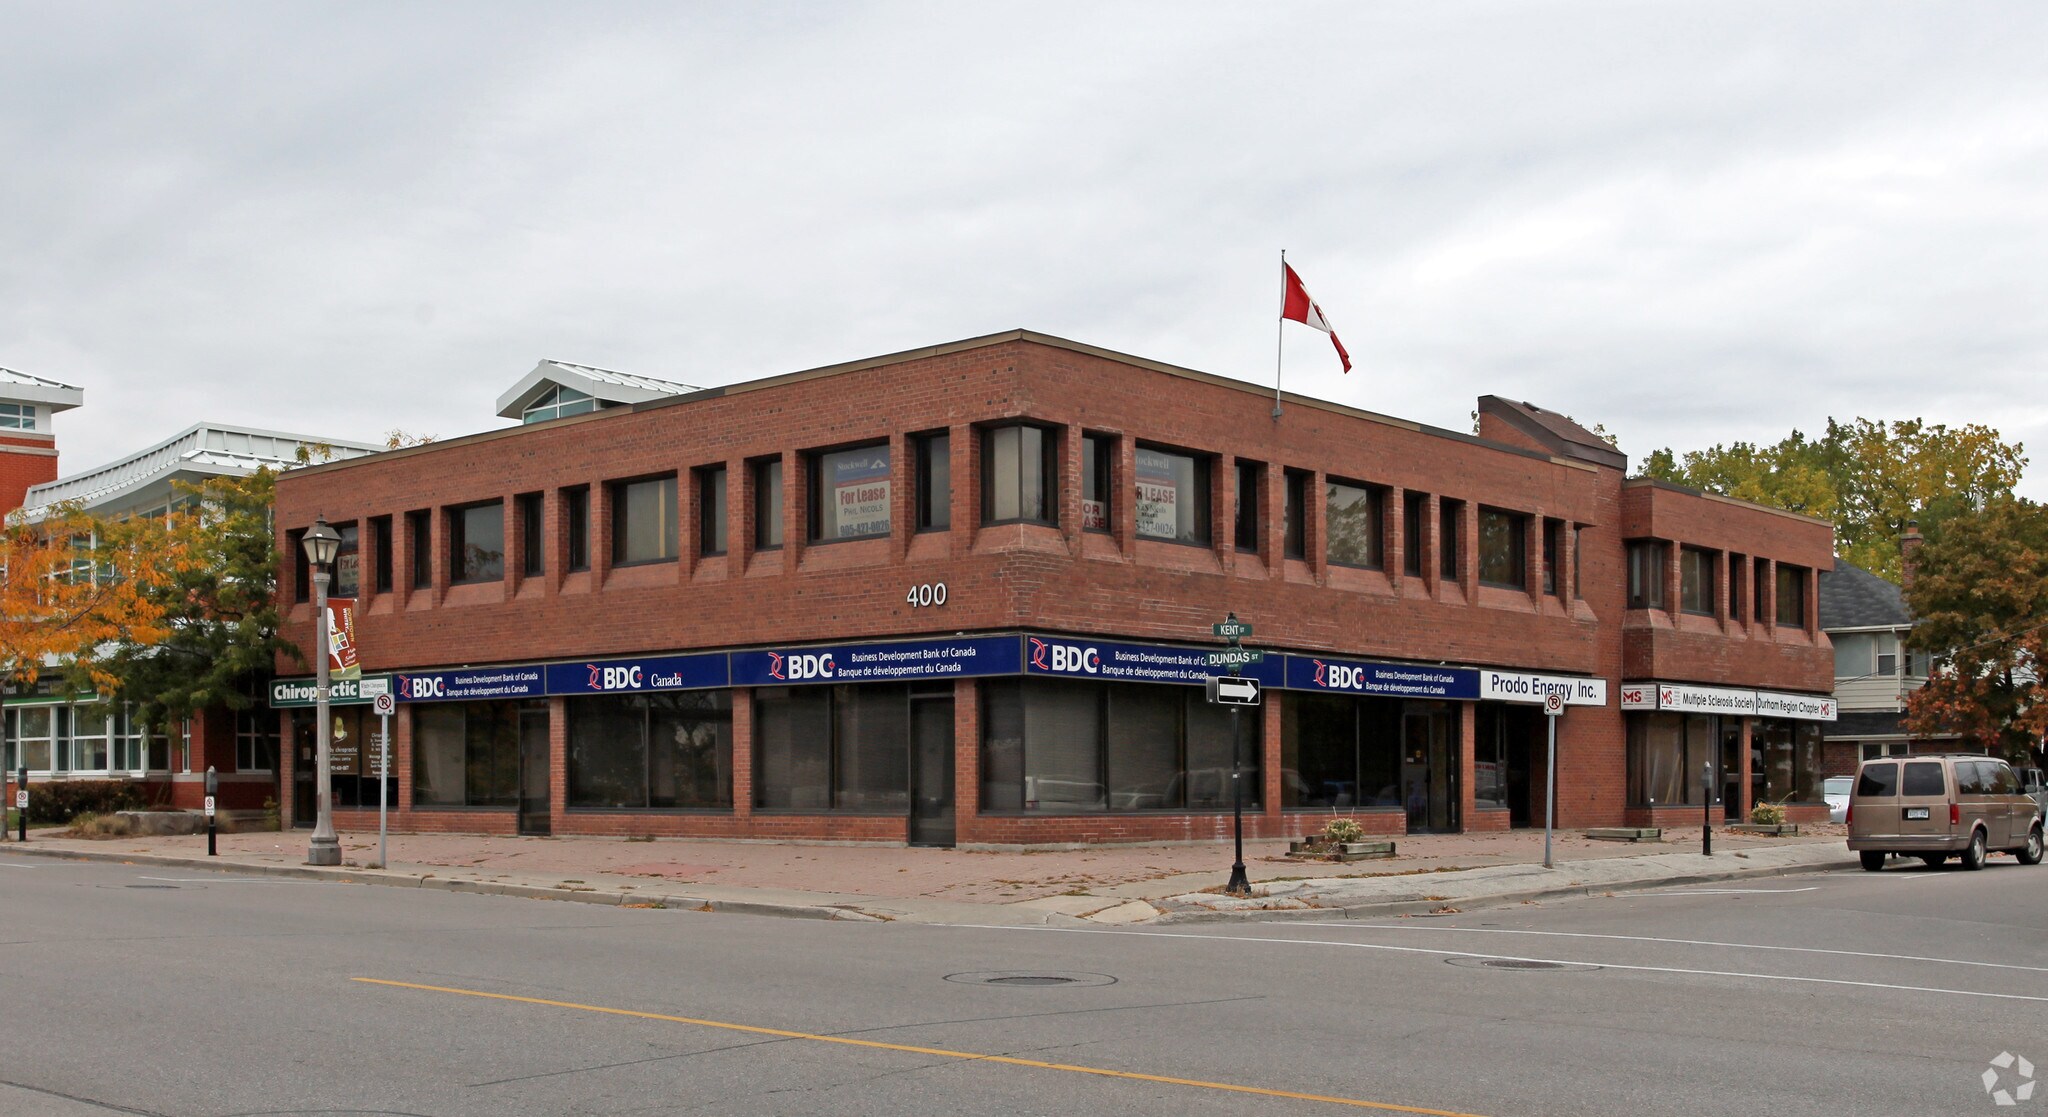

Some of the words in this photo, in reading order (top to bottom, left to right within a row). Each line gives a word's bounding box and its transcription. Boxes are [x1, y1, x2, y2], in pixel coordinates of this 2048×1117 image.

[841, 491, 855, 505] For
[857, 487, 886, 503] Lease
[1145, 487, 1175, 504] LEASE
[1083, 504, 1100, 515] OR
[1083, 517, 1104, 528] ASE
[907, 583, 947, 608] 400
[1221, 625, 1239, 635] KENT
[852, 654, 878, 663] Business
[879, 652, 922, 661] Development
[924, 650, 940, 658] Bank
[942, 648, 949, 657] of
[950, 647, 976, 657] Canada
[1052, 645, 1097, 673] BDC
[1116, 652, 1139, 662] Business
[1140, 653, 1177, 665] Development
[1178, 656, 1194, 666] Bank
[1195, 656, 1200, 666] of
[1210, 653, 1250, 664] DUNDAS
[789, 654, 833, 679] BDC
[839, 668, 862, 678] Banque
[864, 667, 871, 675] de
[873, 665, 923, 677] développement
[925, 664, 934, 673] du
[936, 663, 961, 672] Canada
[1103, 665, 1125, 675] Banque
[1126, 667, 1134, 675] de
[1135, 667, 1179, 679] développement
[1180, 670, 1187, 679] du
[1189, 670, 1209, 680] Canada
[456, 676, 473, 685] Business
[474, 674, 502, 684] Development
[503, 673, 514, 681] Bank
[515, 672, 521, 681] of
[521, 672, 538, 680] Canada
[604, 666, 641, 689] BDC
[651, 673, 682, 687] Canada
[1329, 666, 1362, 689] BDC
[1376, 670, 1393, 679] Business
[1394, 672, 1422, 681] Development
[1434, 674, 1439, 682] of
[1439, 675, 1455, 683] Canada
[274, 681, 357, 701] Chiropctic
[413, 677, 443, 698] BDC
[447, 688, 462, 698] Banque
[464, 687, 469, 695] de
[505, 686, 510, 694] du
[511, 685, 528, 693] Canada
[1366, 682, 1383, 691] Banque
[1424, 685, 1429, 693] du
[1430, 686, 1445, 694] Canada
[1492, 674, 1528, 694] Prodo
[1533, 678, 1573, 701] Energy
[1579, 681, 1597, 698] Inc.
[1623, 691, 1642, 703] MS
[1662, 690, 1672, 705] MS
[1683, 693, 1707, 707] Multiple
[1709, 694, 1733, 707] Sclerosis
[1735, 697, 1755, 711] Society
[1758, 698, 1779, 711] Durham
[1780, 700, 1798, 714] Region
[1799, 702, 1820, 715] Chapter
[1821, 703, 1830, 716] MS
